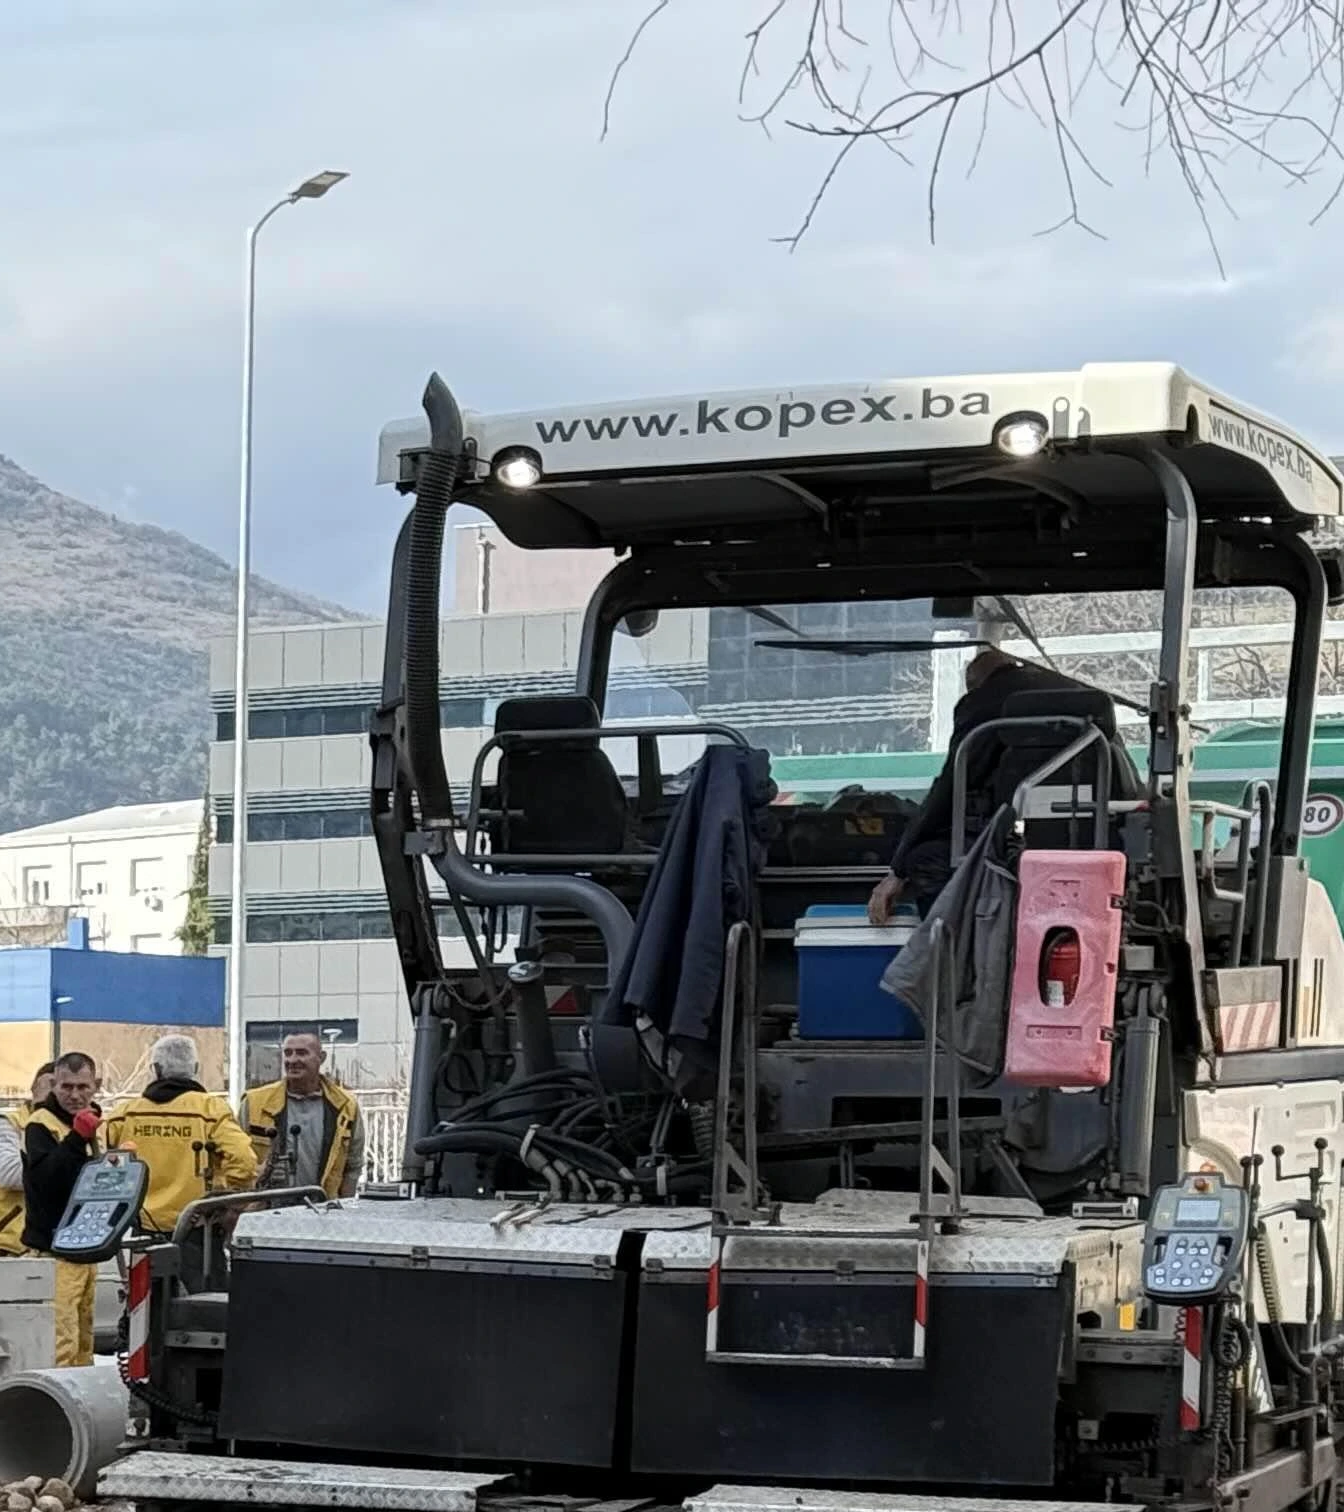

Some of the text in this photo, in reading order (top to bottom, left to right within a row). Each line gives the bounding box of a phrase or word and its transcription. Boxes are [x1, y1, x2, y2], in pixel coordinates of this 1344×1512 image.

[536, 387, 991, 443] www.kopex.ba
[1208, 412, 1313, 483] www.kopex.ba
[1304, 806, 1331, 823] 80
[133, 1125, 192, 1137] HERING
